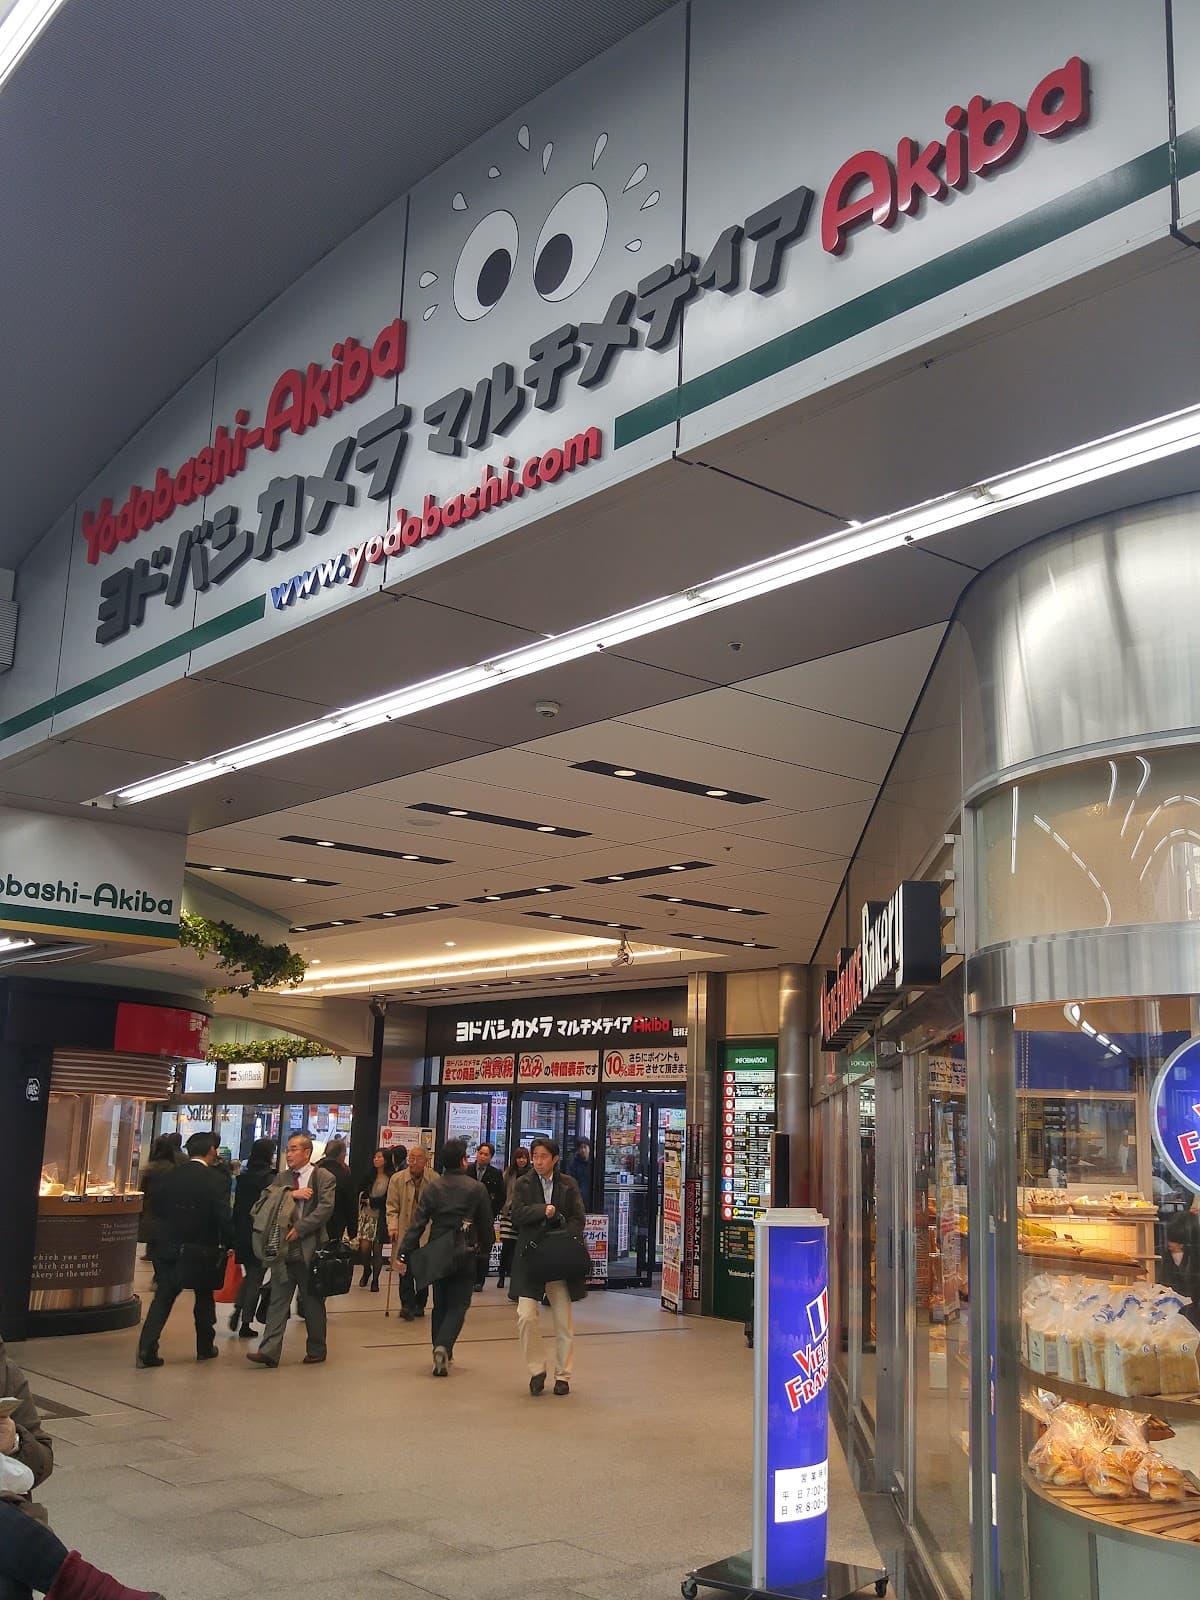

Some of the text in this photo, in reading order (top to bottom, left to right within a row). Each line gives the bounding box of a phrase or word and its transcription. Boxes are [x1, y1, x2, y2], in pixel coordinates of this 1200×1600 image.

[96, 55, 1091, 645] ヨドバシカメラ マルチメディア Akiba
[82, 317, 407, 565] Yodobashi-Akiba
[270, 426, 602, 610] www.yodobashi.com
[861, 883, 904, 1000] Bakery
[456, 1016, 553, 1042] ヨドバシカメラ
[556, 1016, 632, 1036] マルチメディア
[632, 1014, 671, 1033] Akiba
[628, 1052, 680, 1063] さらにポイントも
[735, 1056, 768, 1064] INFORMATION
[238, 1070, 262, 1081] SoftBank
